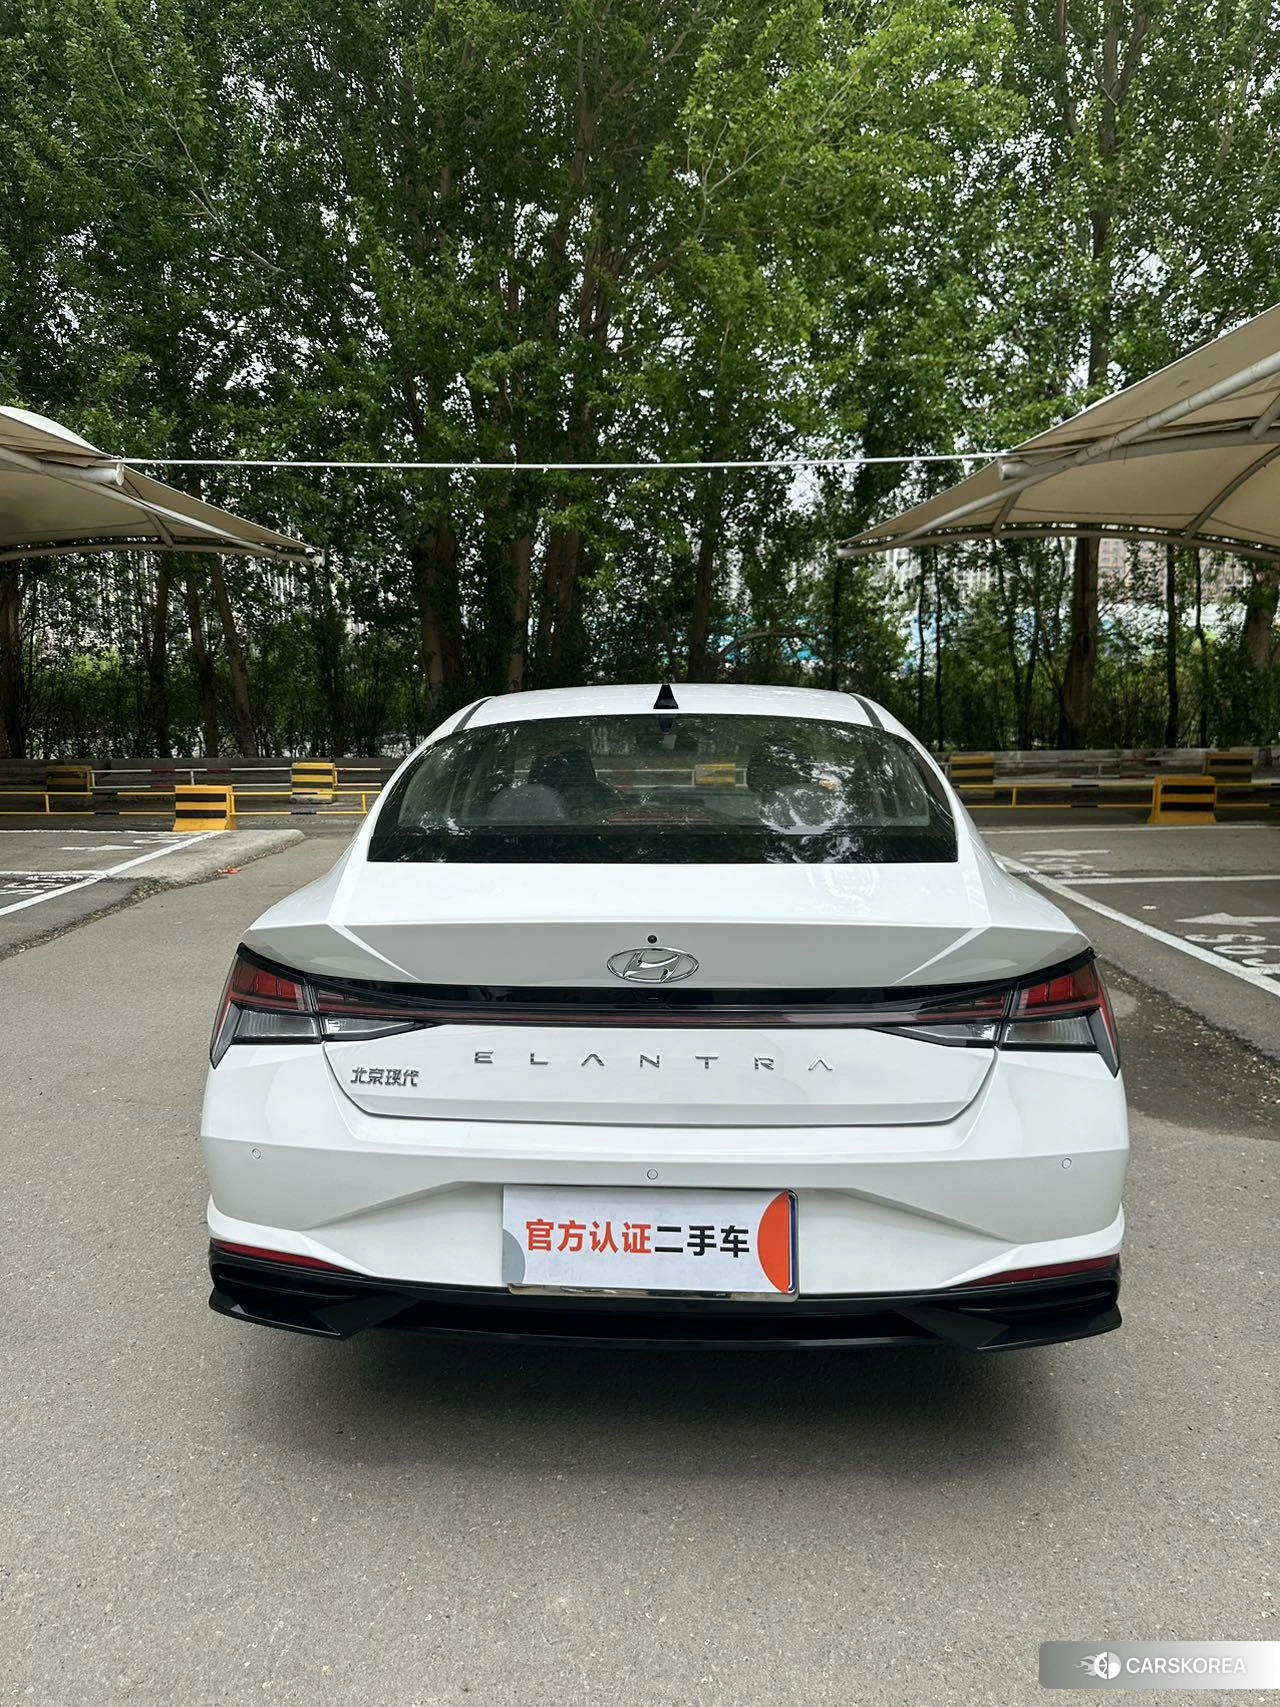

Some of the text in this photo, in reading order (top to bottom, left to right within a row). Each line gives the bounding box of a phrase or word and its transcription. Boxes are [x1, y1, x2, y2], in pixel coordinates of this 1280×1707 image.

[474, 1050, 833, 1072] ELANTRA
[350, 1066, 420, 1088] 北京现代
[525, 1218, 750, 1258] 官方认证二手车
